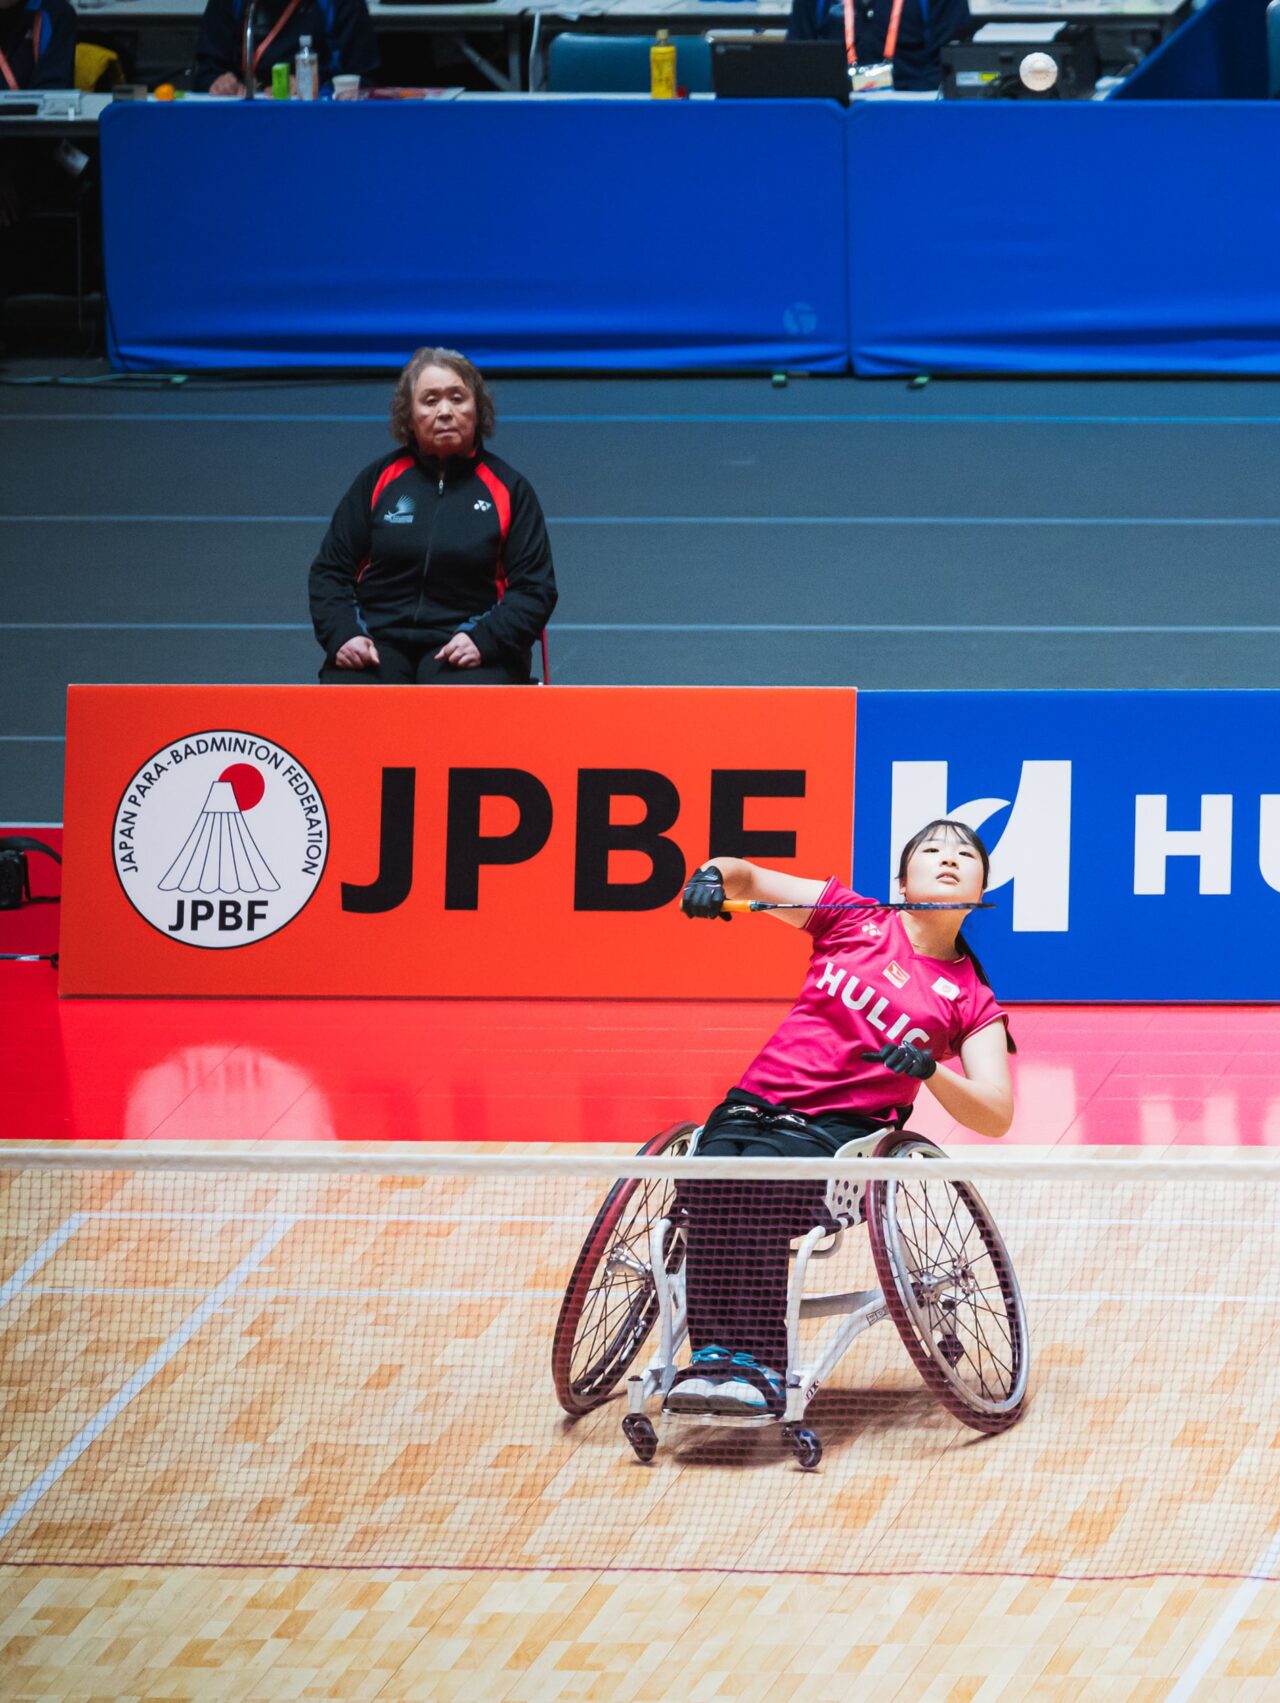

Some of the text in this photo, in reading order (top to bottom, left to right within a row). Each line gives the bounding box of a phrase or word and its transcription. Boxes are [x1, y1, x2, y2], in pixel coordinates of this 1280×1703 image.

[119, 736, 323, 876] JAPAN PARA-BADMINTON FEDERATION
[340, 766, 806, 914] JPBF
[168, 900, 269, 932] JPBF
